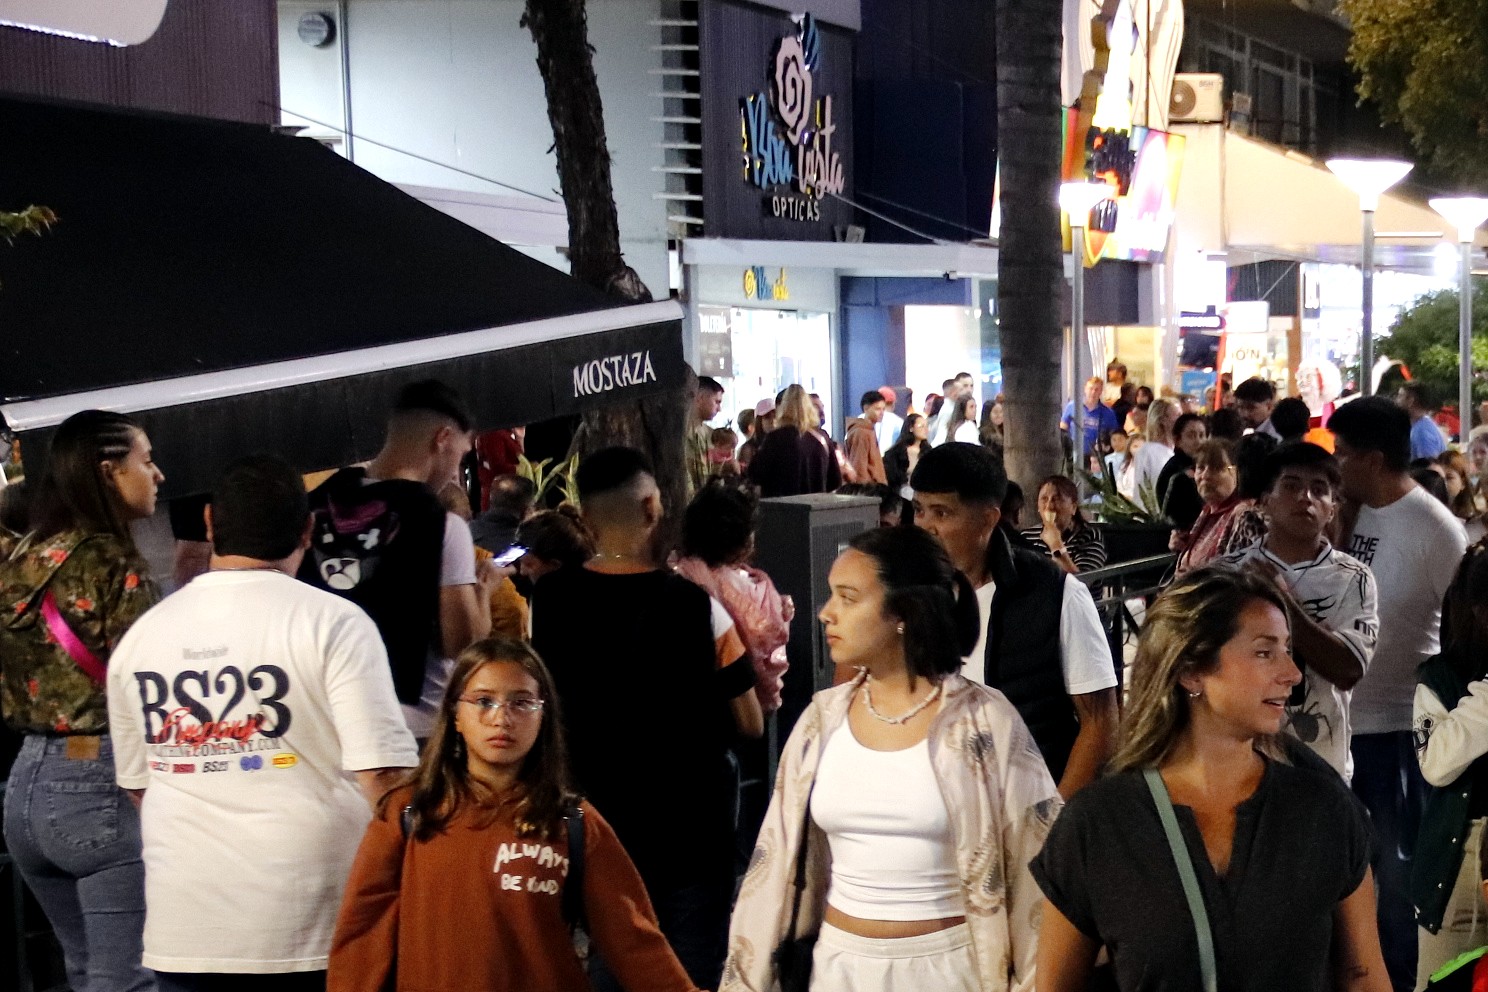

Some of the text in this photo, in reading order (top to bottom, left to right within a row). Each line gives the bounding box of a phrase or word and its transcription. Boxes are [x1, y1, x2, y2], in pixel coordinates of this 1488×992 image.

[573, 350, 656, 398] MOSTAZA
[1353, 534, 1379, 552] THE
[133, 664, 292, 744] BS23
[501, 874, 522, 891] BE
